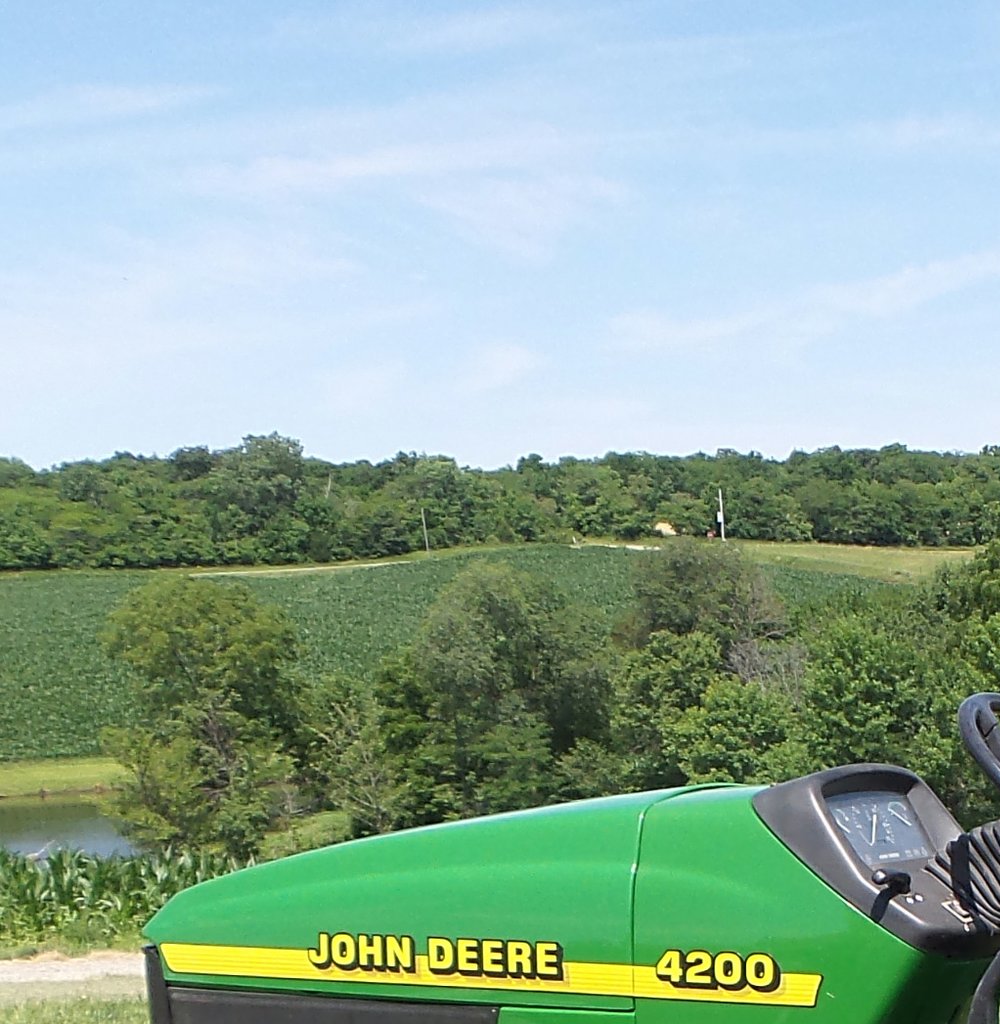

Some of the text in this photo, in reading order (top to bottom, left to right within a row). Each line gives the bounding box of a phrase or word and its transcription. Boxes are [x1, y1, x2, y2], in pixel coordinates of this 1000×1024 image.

[307, 931, 565, 982] JOHN DEERE
[655, 949, 781, 992] 4200
